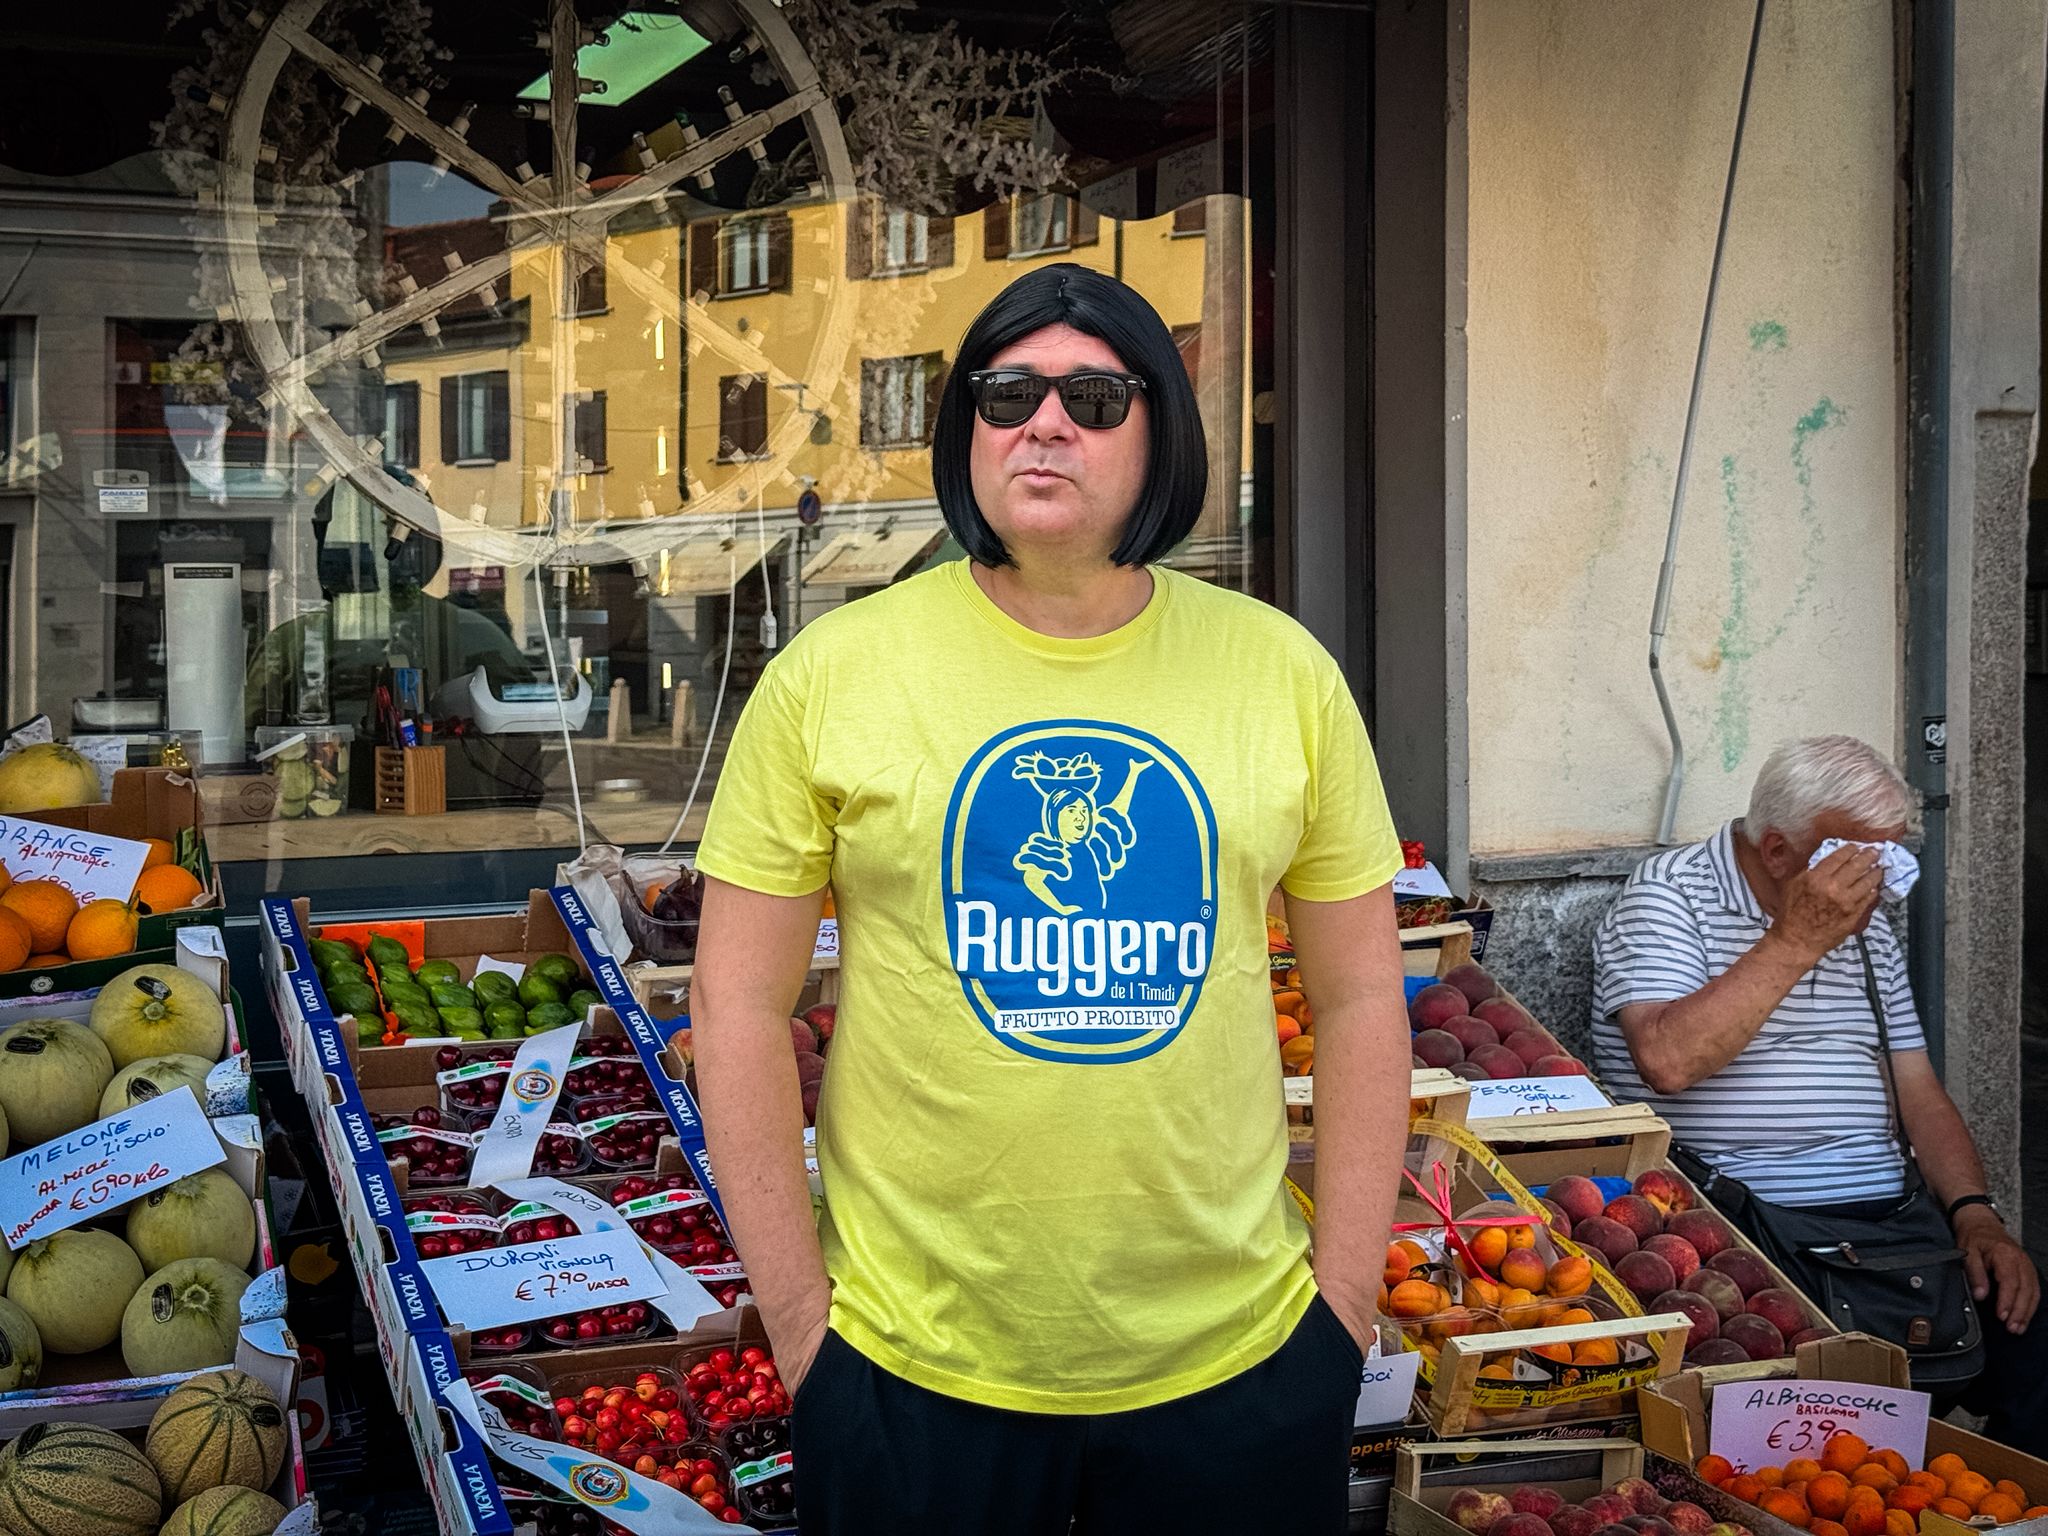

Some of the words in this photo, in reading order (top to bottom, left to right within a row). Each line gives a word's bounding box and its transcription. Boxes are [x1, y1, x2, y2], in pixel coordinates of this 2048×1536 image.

[273, 906, 294, 938] VIGNOLA
[560, 892, 586, 926] VIGNOLA
[955, 901, 1207, 997] Ruggero
[298, 979, 321, 1012] VIGNOLA
[598, 963, 625, 996] VIGNOLA
[1110, 982, 1126, 999] de
[1137, 983, 1176, 1001] Timidi
[626, 1010, 655, 1045] VIGNOLA
[1000, 1010, 1079, 1029] FRUTTO
[1085, 1009, 1177, 1026] PROIBITO
[320, 1029, 341, 1066] VIGNOLA
[668, 1089, 697, 1126] VIGNOLA
[21, 1119, 132, 1176] MELONE
[346, 1113, 373, 1152] VIGNOLA
[367, 1175, 392, 1217] VIGNOLA
[398, 1273, 426, 1320] VIGNOLA
[587, 1277, 631, 1292] VASCA
[463, 1463, 496, 1519] VIGNOLA
